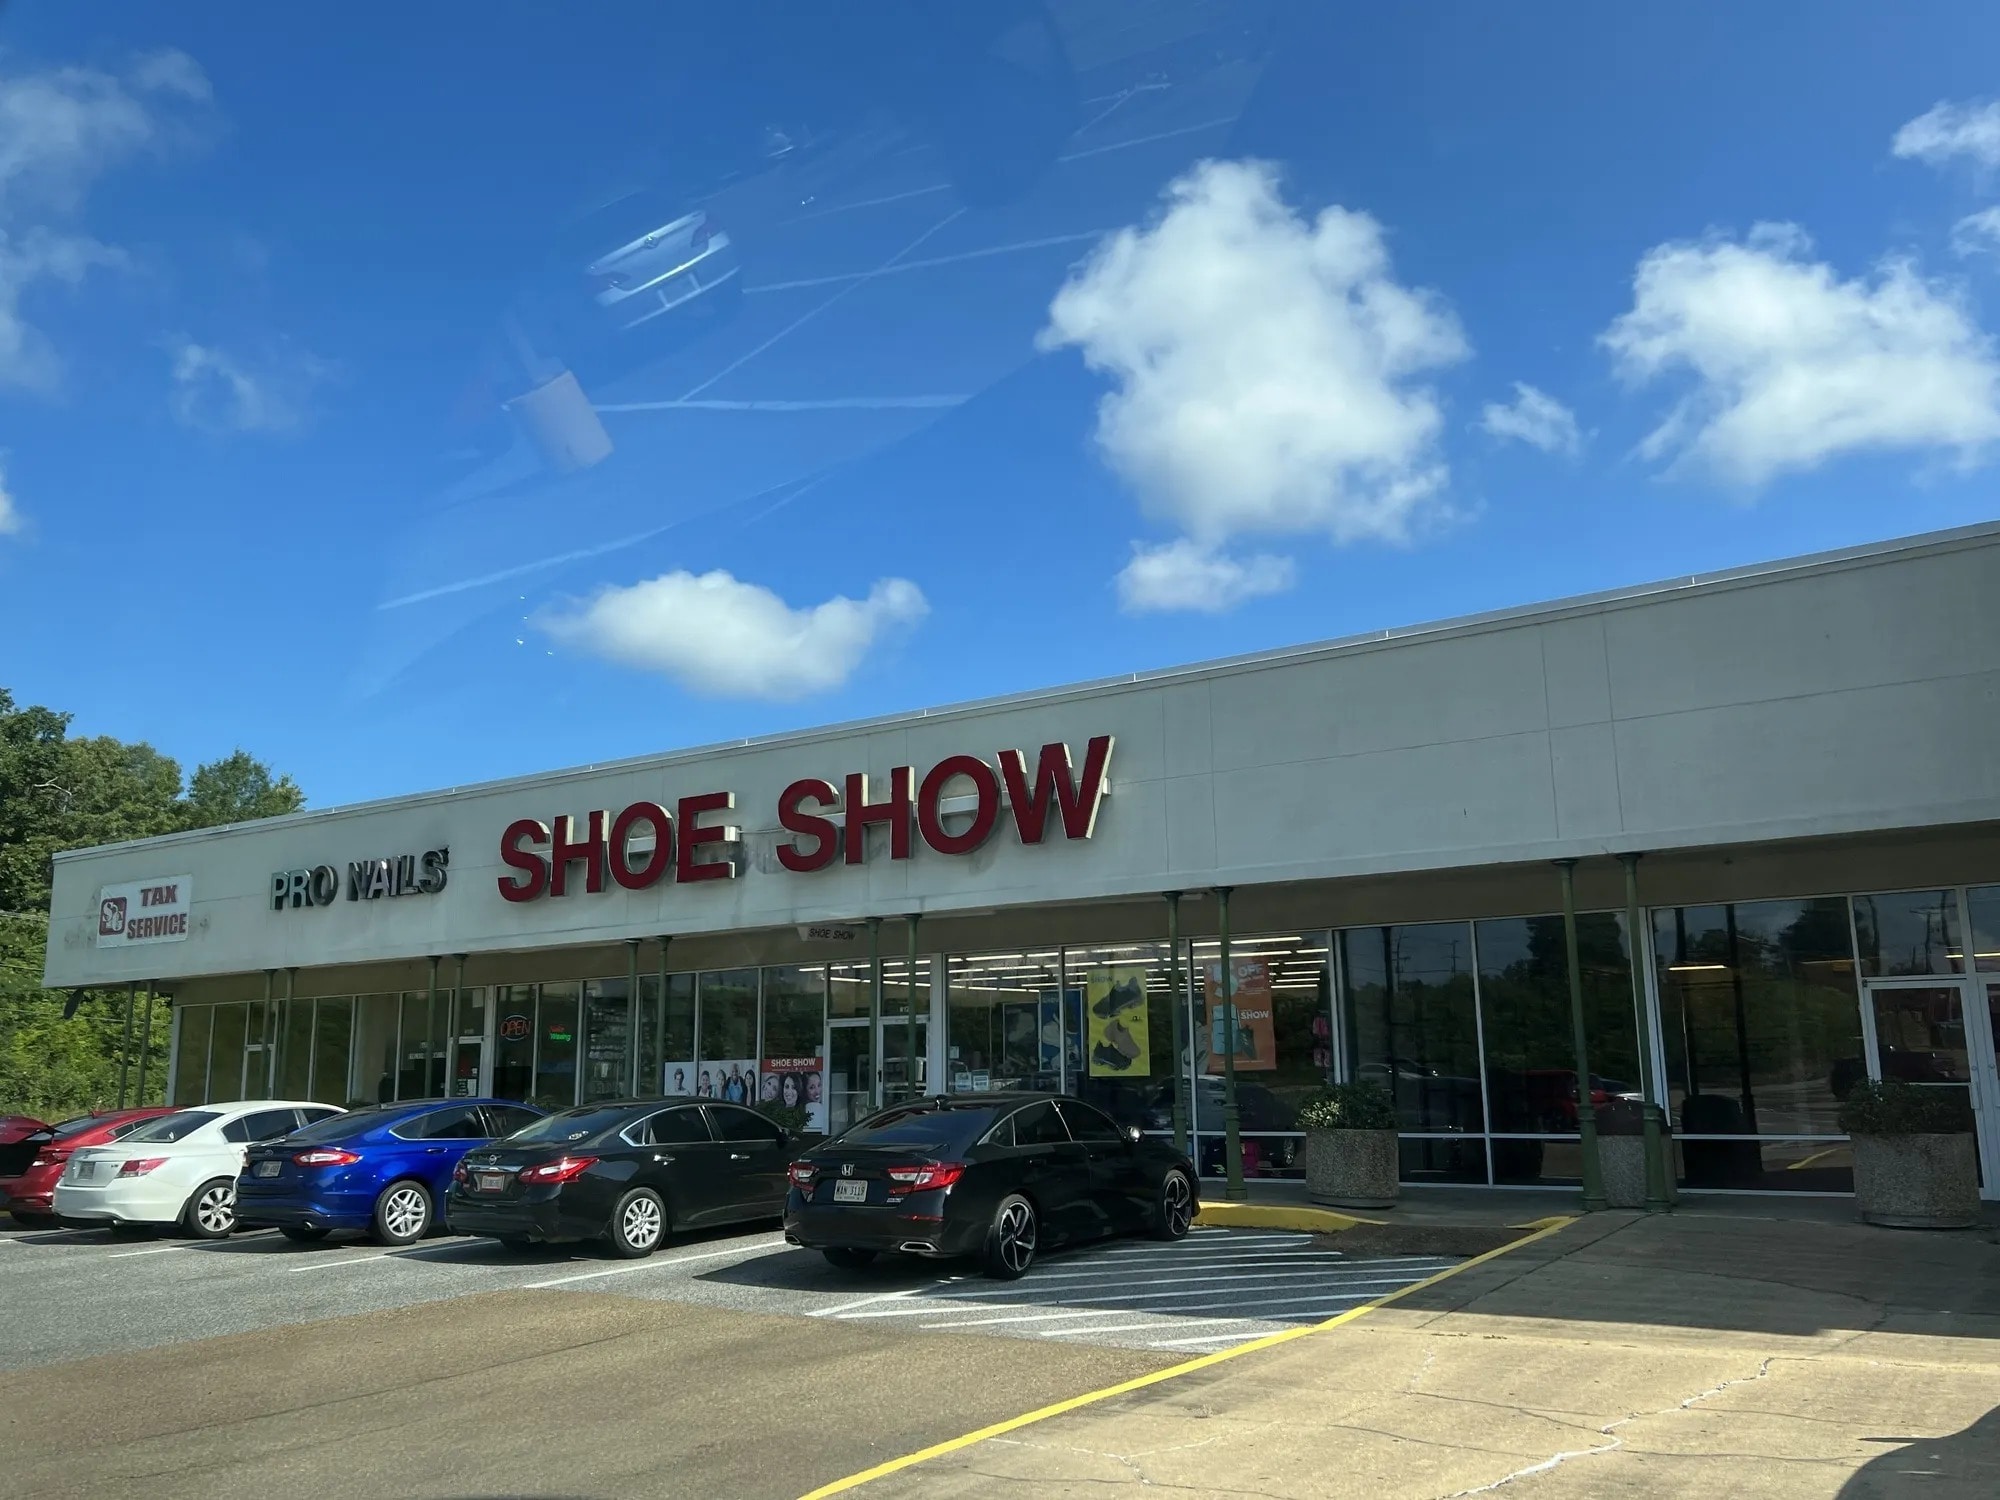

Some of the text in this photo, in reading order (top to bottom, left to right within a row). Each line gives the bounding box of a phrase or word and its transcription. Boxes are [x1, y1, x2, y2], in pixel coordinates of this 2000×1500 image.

[498, 735, 1115, 903] SHOE SHOW
[270, 849, 449, 911] PRO NAILS
[140, 884, 178, 907] TAX
[127, 913, 188, 940] SERVICE
[808, 928, 856, 941] SHOE SHOW
[1237, 963, 1264, 978] OFF
[1240, 1010, 1270, 1021] SHOW
[500, 1019, 532, 1036] OPEN
[771, 1057, 816, 1067] SHOE SHOW
